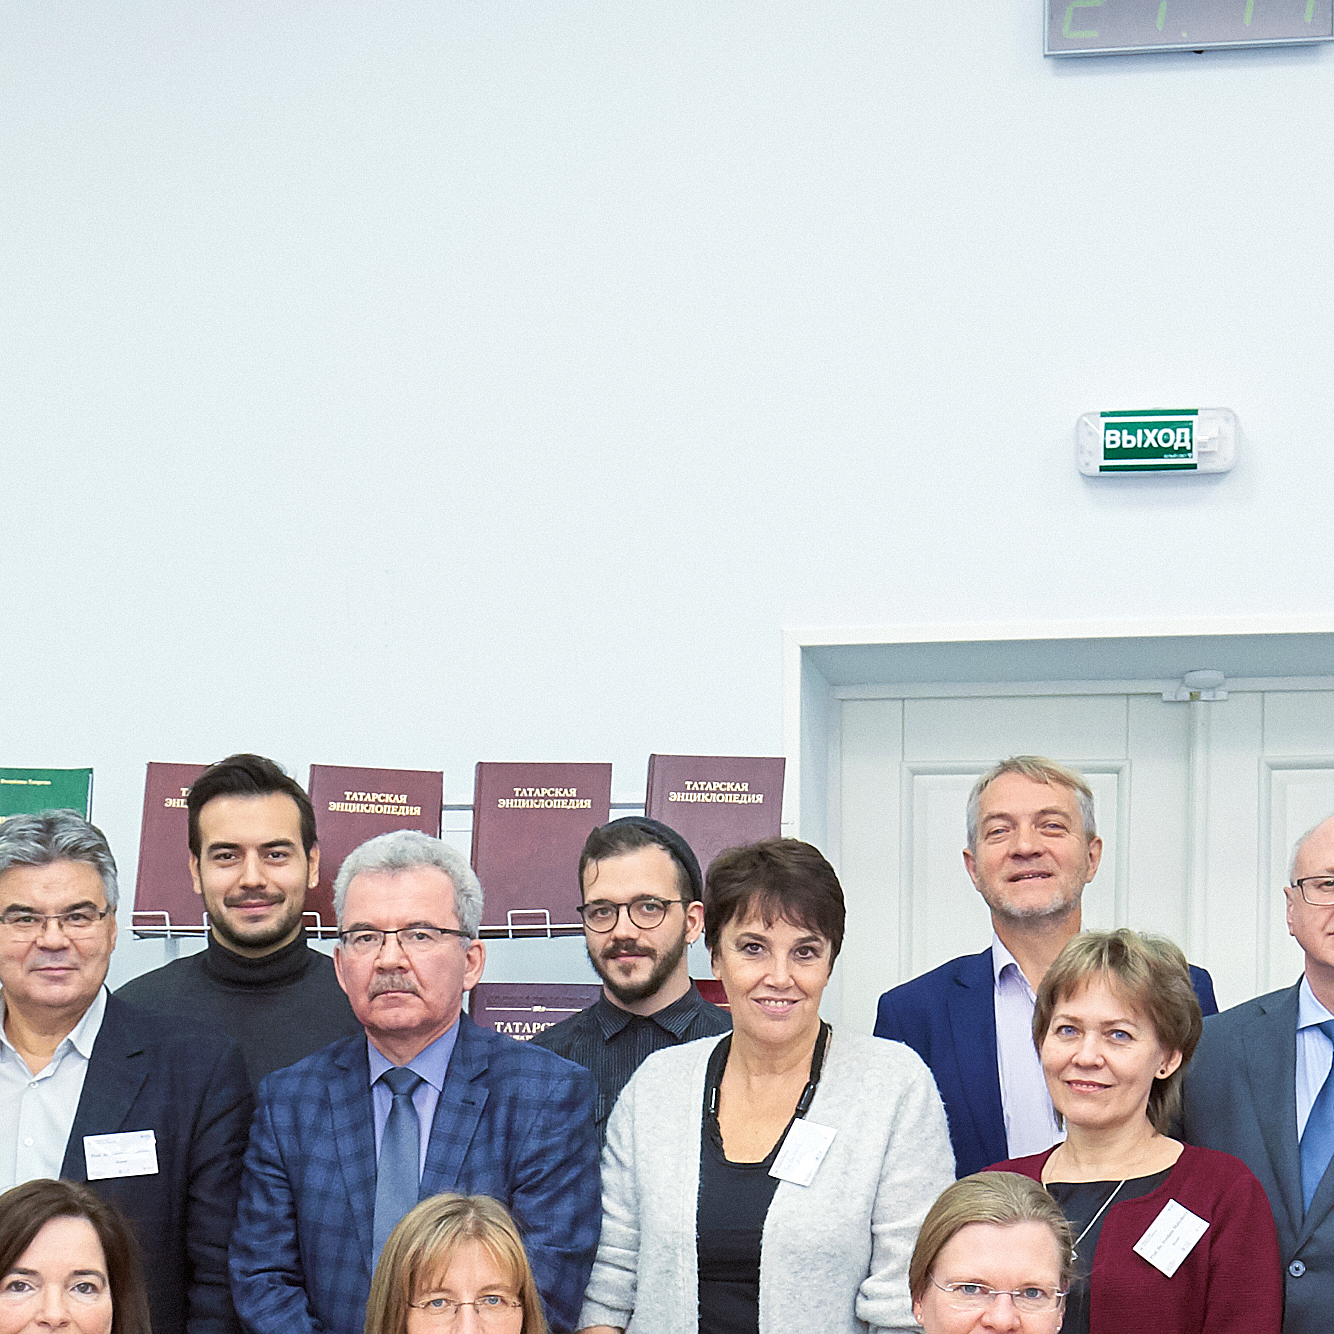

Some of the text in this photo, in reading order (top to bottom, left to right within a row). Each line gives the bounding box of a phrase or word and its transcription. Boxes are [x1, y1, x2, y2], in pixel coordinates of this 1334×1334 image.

[1105, 427, 1191, 451] ВЫХОД
[513, 787, 577, 798] ТАТАРСКАЯ
[685, 780, 749, 792] ТАТАРСКАЯ
[344, 791, 408, 804] ТАТАРСКАЯ
[497, 798, 592, 809] ЭНЦИКЛОПЕДИЯ
[669, 791, 764, 804] ЭНЦИКЛОПЕДИЯ
[328, 802, 421, 816] ЭНЦИКЛОПЕДИЯ
